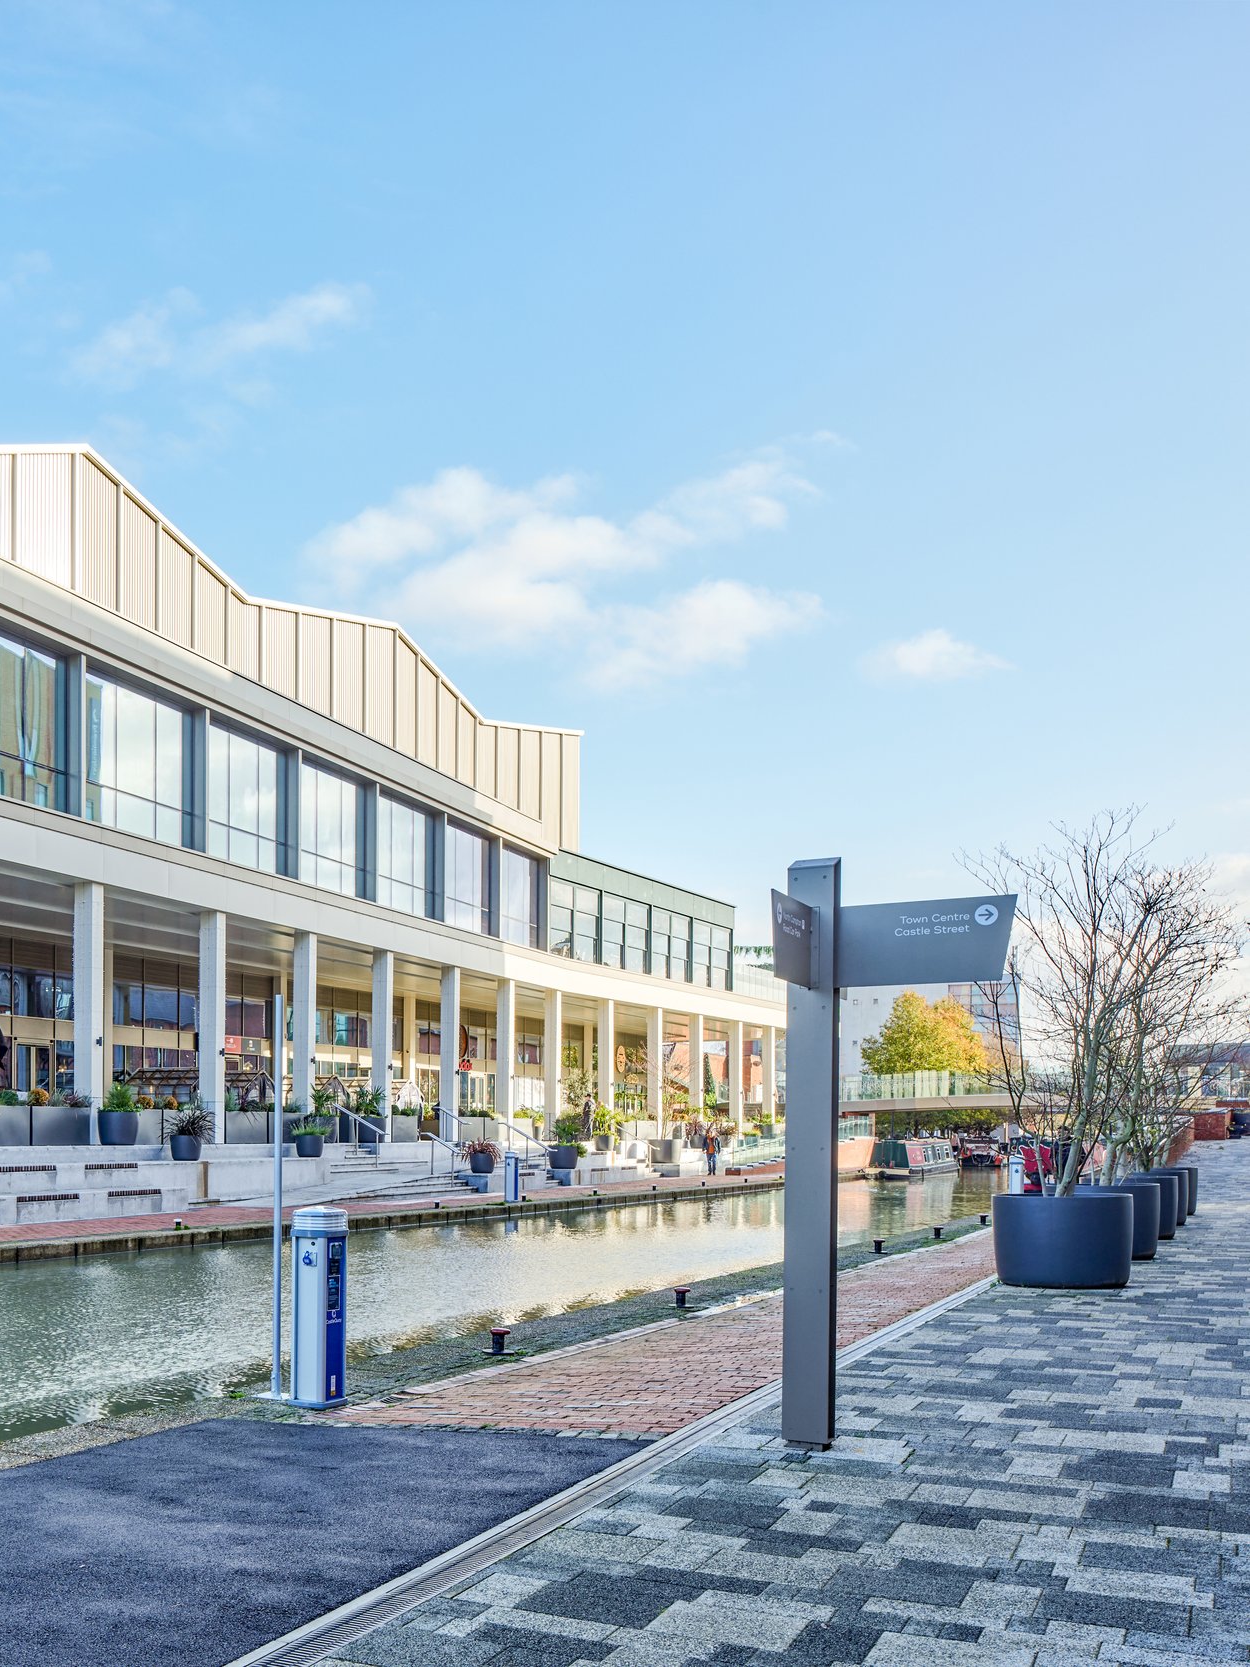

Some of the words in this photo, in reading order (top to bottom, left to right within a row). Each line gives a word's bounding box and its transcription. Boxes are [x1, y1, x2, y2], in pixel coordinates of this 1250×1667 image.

[899, 915, 928, 925] Town
[931, 913, 970, 922] Centre
[894, 927, 931, 937] Castle
[933, 925, 970, 935] Street
